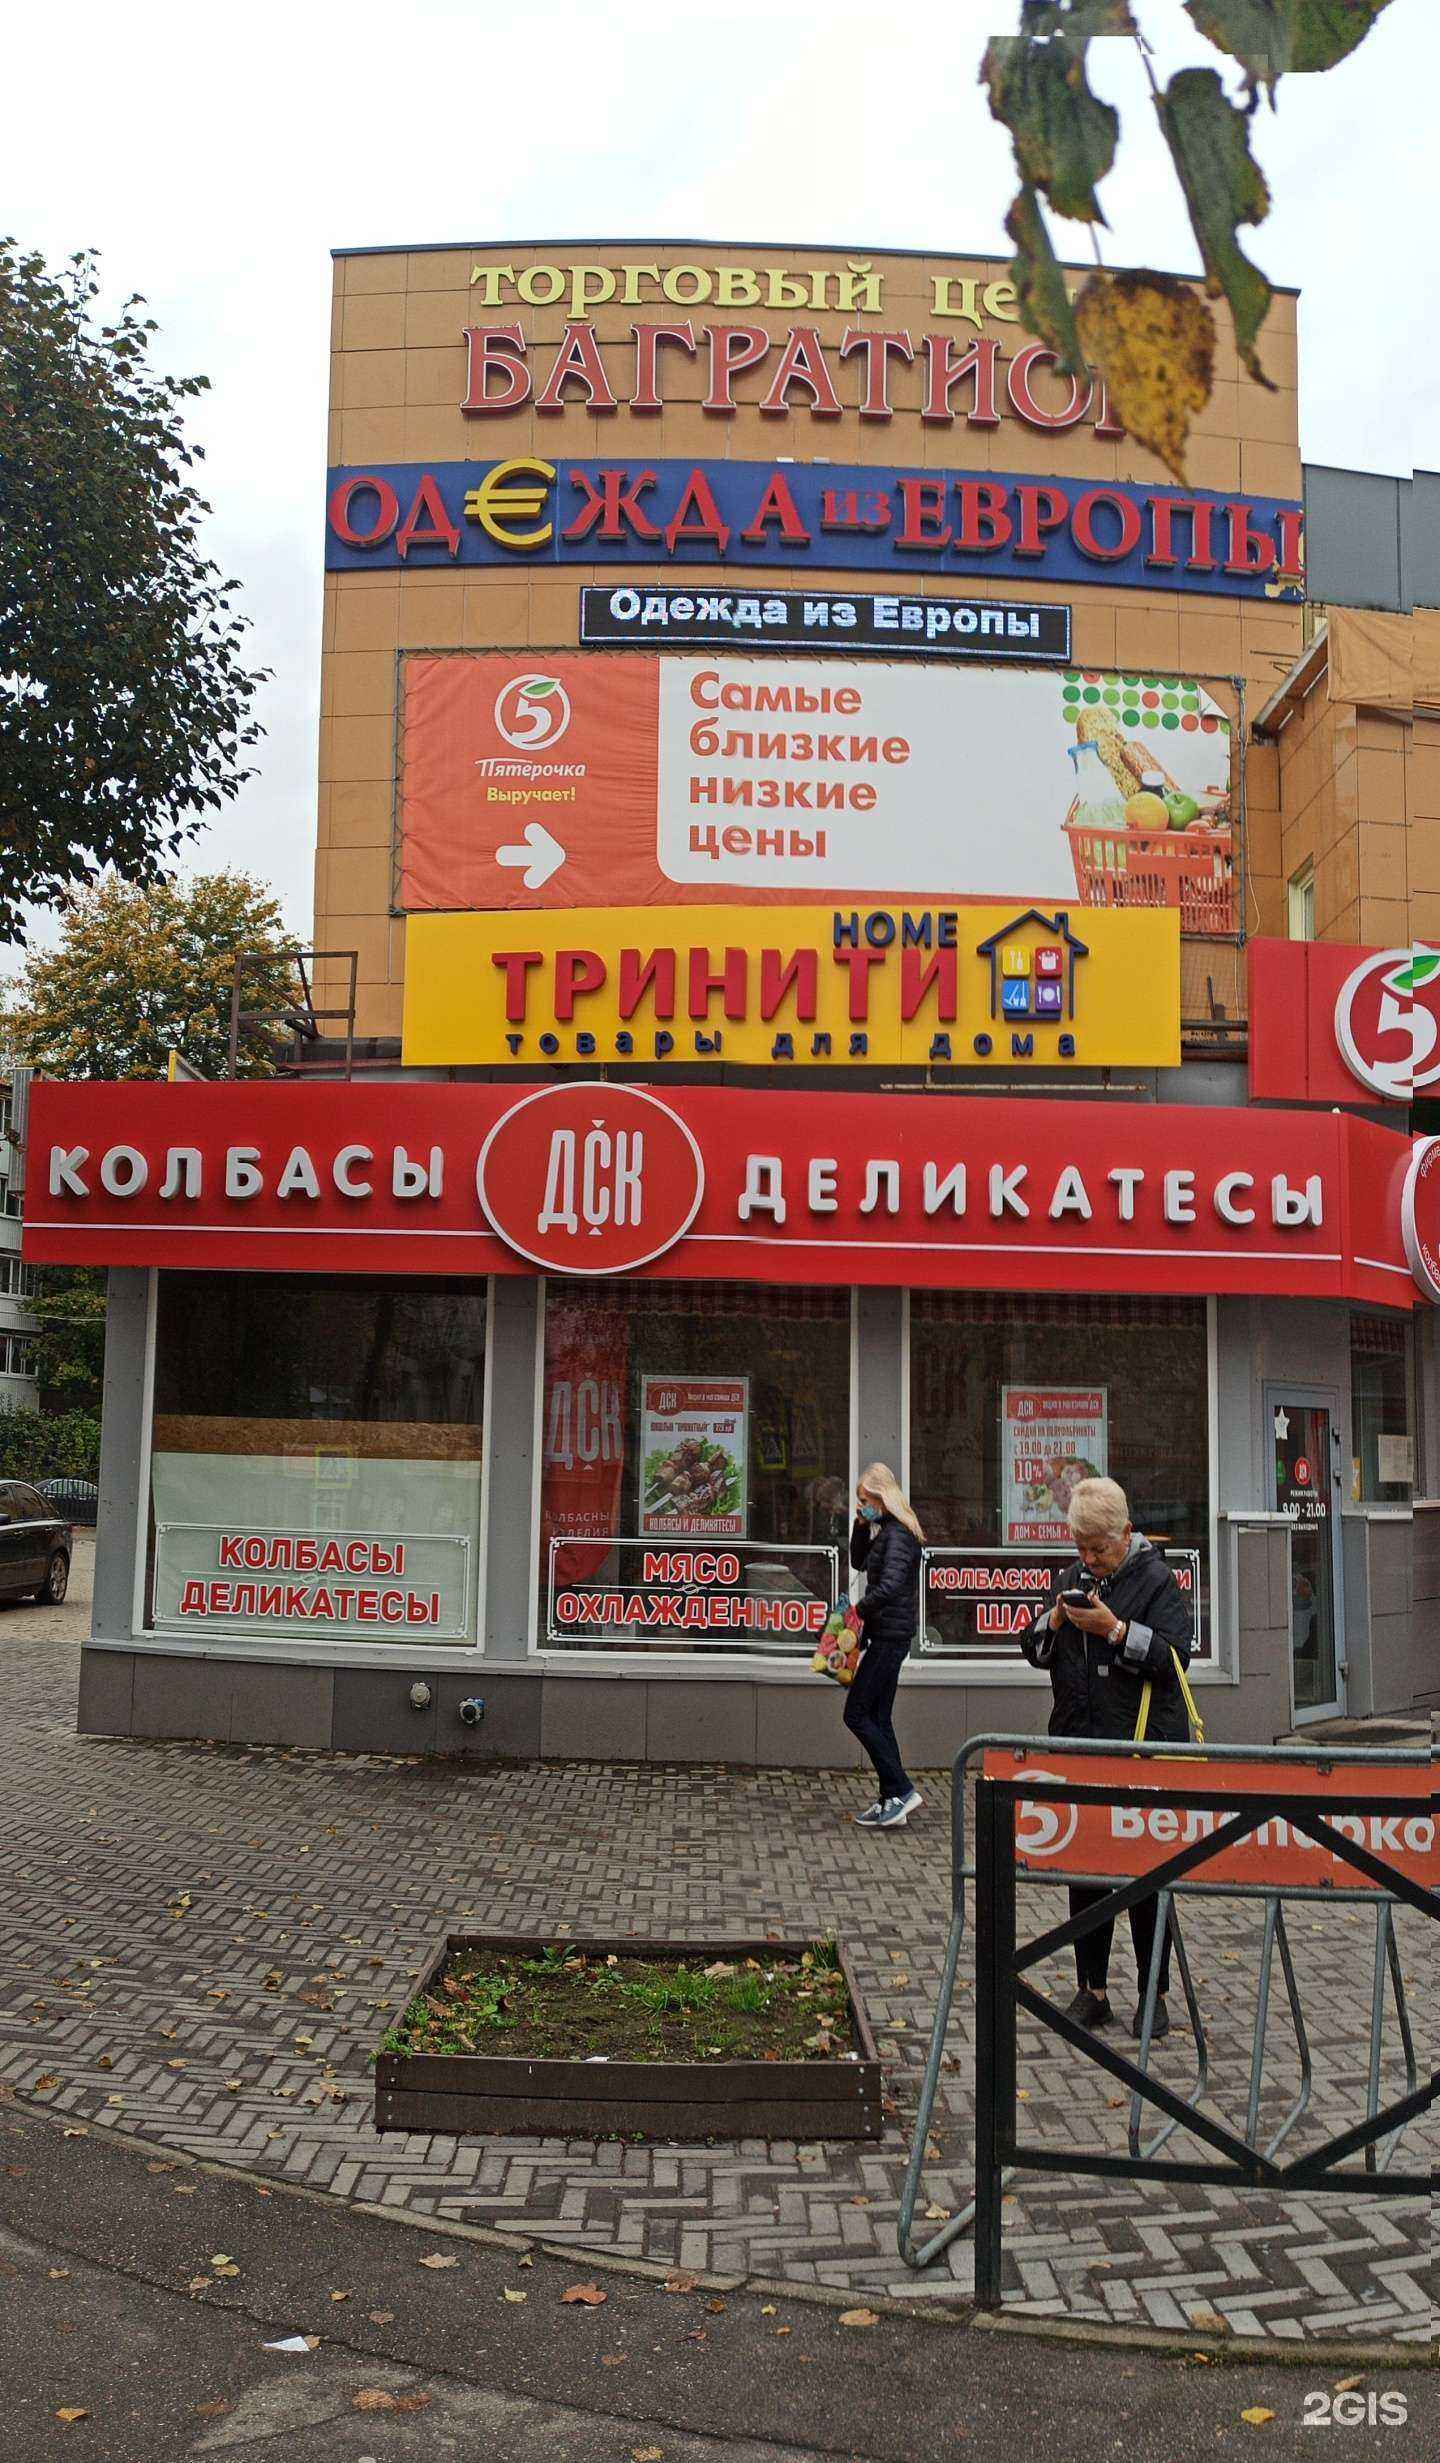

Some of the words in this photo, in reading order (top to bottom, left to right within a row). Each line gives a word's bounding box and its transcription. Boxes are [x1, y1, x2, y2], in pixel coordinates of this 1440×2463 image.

[470, 260, 885, 319] торговый
[894, 478, 1305, 576] ЕВРОПЫ
[608, 588, 788, 631] Одежда
[803, 599, 858, 628] из
[872, 595, 1040, 640] Европы
[689, 670, 862, 715] Самые
[689, 716, 911, 765] близкие
[486, 786, 576, 805] Выручает!
[689, 775, 878, 812] низкие
[689, 823, 827, 861] цены
[833, 911, 958, 949] HOME
[491, 947, 958, 1023] ТРИНИТИ
[505, 1028, 722, 1060] товары
[771, 1030, 868, 1060] для
[929, 1030, 1076, 1060] дома
[49, 1143, 444, 1199] КОЛБАСЫ
[537, 1128, 644, 1235] ДСК
[738, 1152, 1323, 1227] ДЕЛИКАТЕСЫ
[218, 1536, 406, 1577] КОЛБАСЫ
[643, 1552, 740, 1585] МЯСО
[929, 1567, 1051, 1591] КОЛБАСКИ
[180, 1579, 440, 1625] ДЕЛИКАТЕСЫ
[556, 1591, 829, 1633] ОХЛАЖДЕННОЕ
